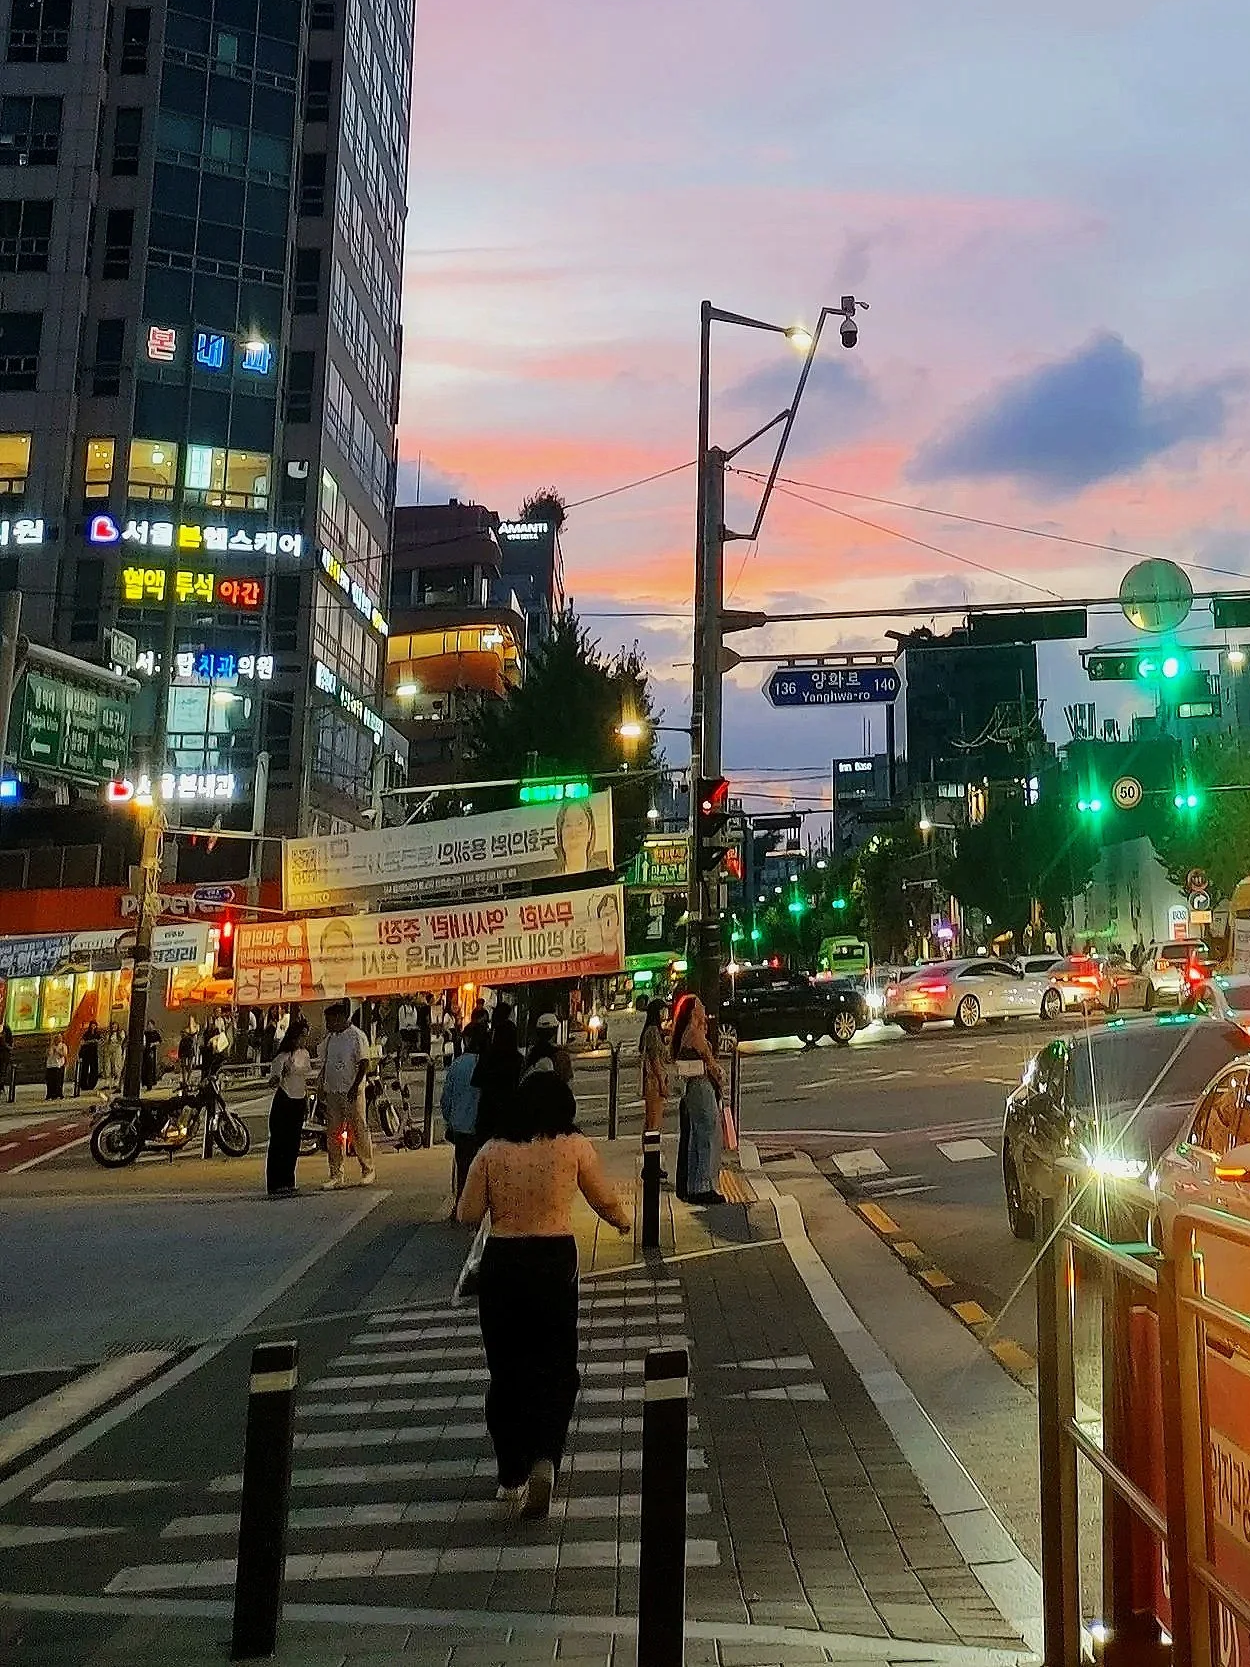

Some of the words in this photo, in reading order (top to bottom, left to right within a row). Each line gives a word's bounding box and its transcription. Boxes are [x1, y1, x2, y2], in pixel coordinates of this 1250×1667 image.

[498, 522, 548, 536] AMANTI
[123, 566, 165, 601] 혈액
[175, 571, 215, 602] 투석
[219, 580, 261, 605] 야간
[775, 682, 797, 695] 136
[811, 671, 861, 690] 양화로
[874, 677, 895, 692] 140
[802, 690, 871, 704] Yanghwa-ro
[1120, 786, 1135, 799] 50
